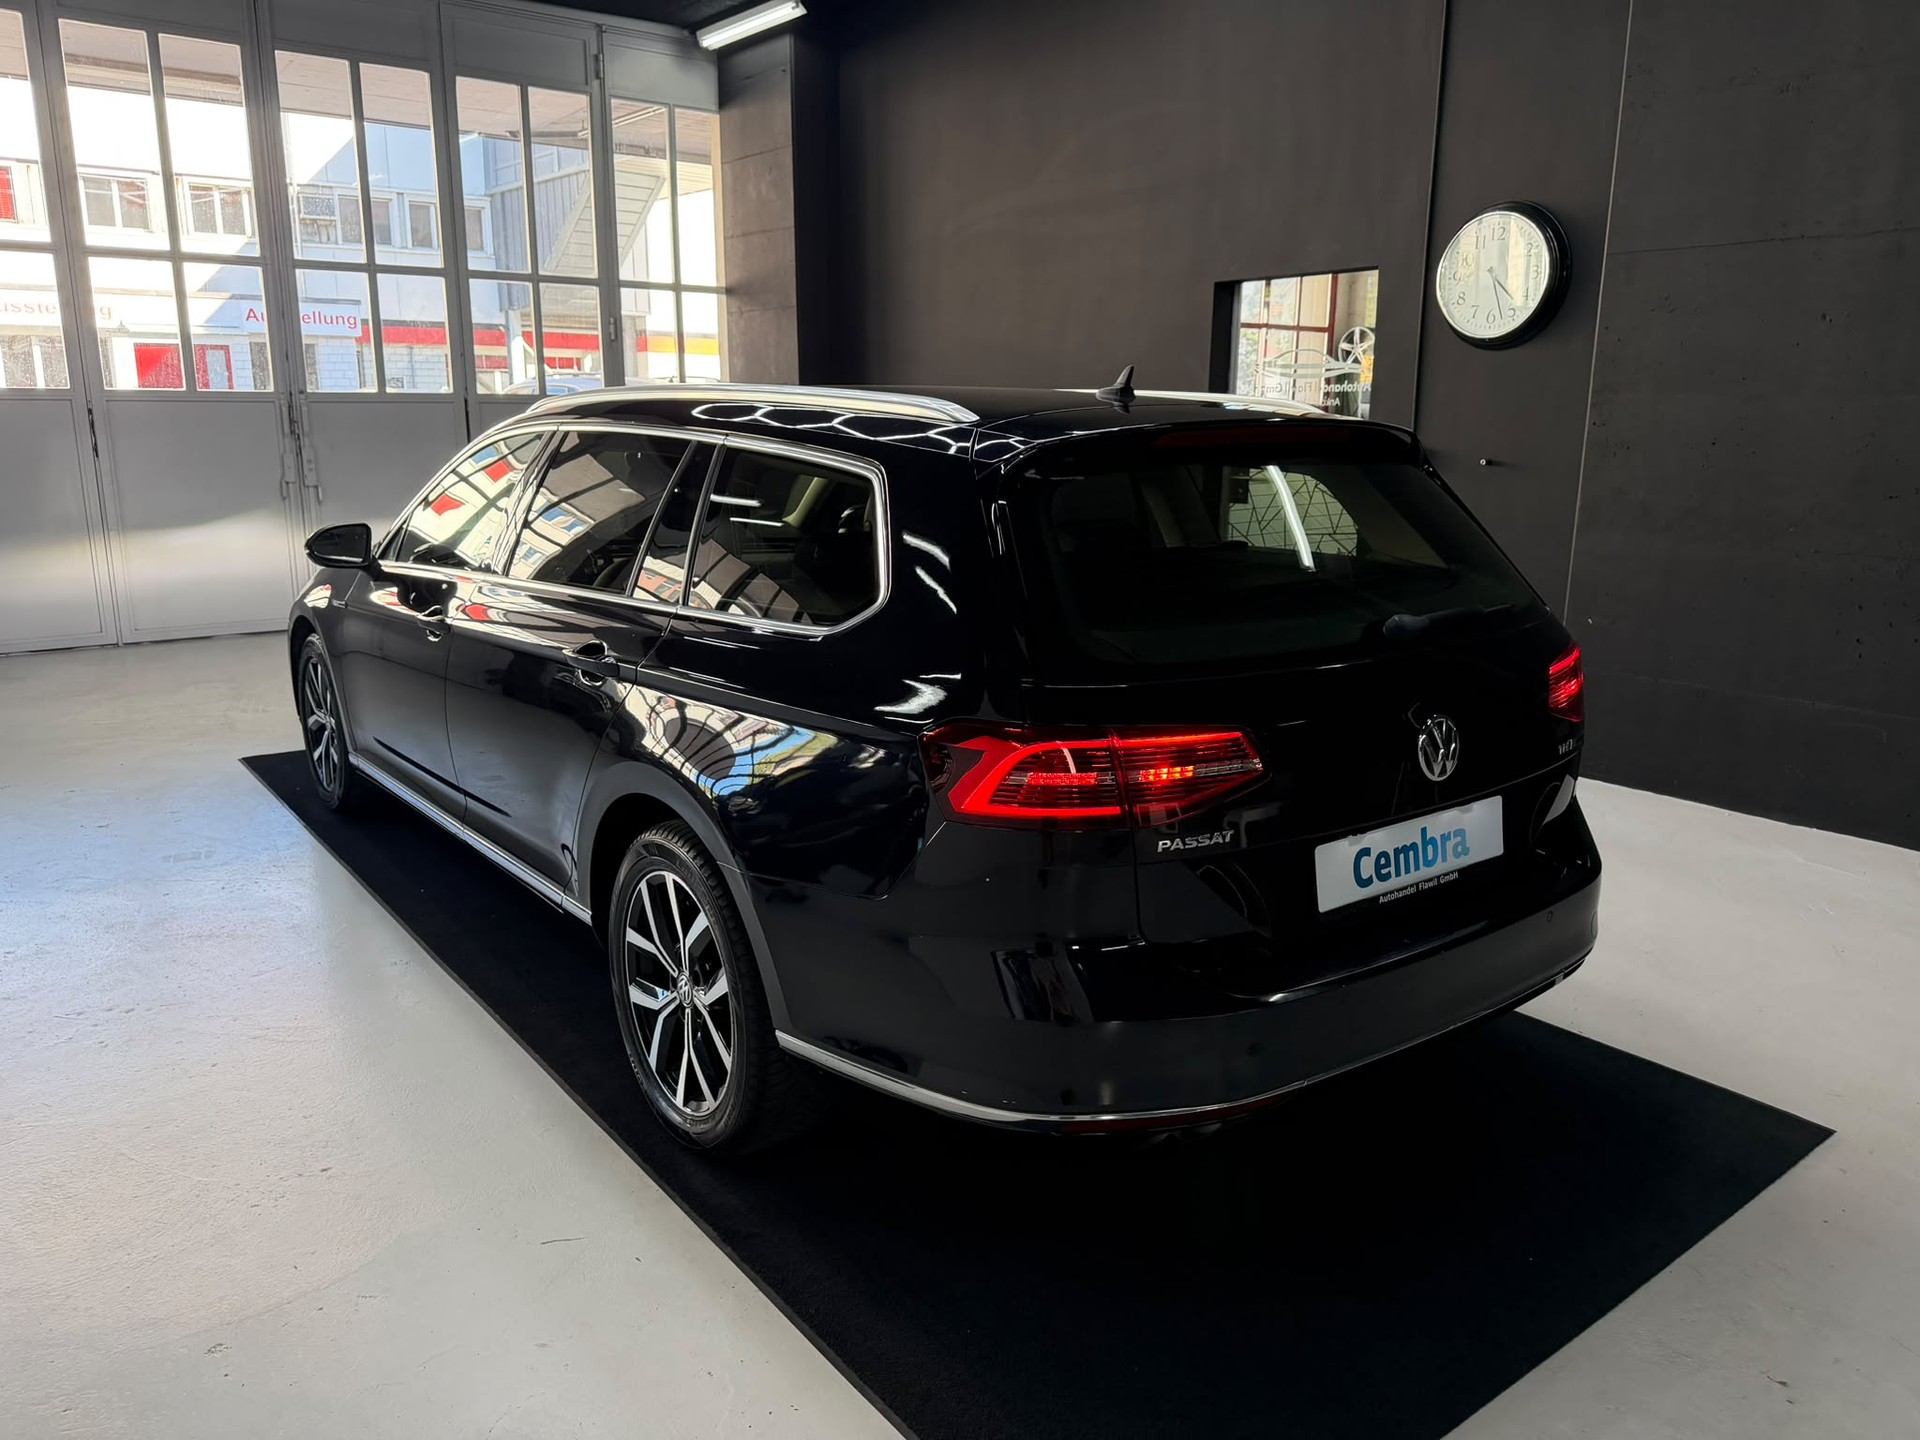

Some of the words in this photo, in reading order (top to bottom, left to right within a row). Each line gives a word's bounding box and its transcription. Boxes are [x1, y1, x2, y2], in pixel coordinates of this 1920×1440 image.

[1491, 226, 1506, 241] 12
[1474, 235, 1487, 250] 11
[1531, 265, 1540, 280] 3
[1456, 291, 1466, 306] 8
[1471, 304, 1480, 319] 7
[1486, 308, 1496, 324] 6
[1157, 830, 1235, 853] PASSAT
[1353, 826, 1470, 889] Cembra
[1379, 884, 1417, 903] Autohandel
[1439, 870, 1459, 884] GmbH
